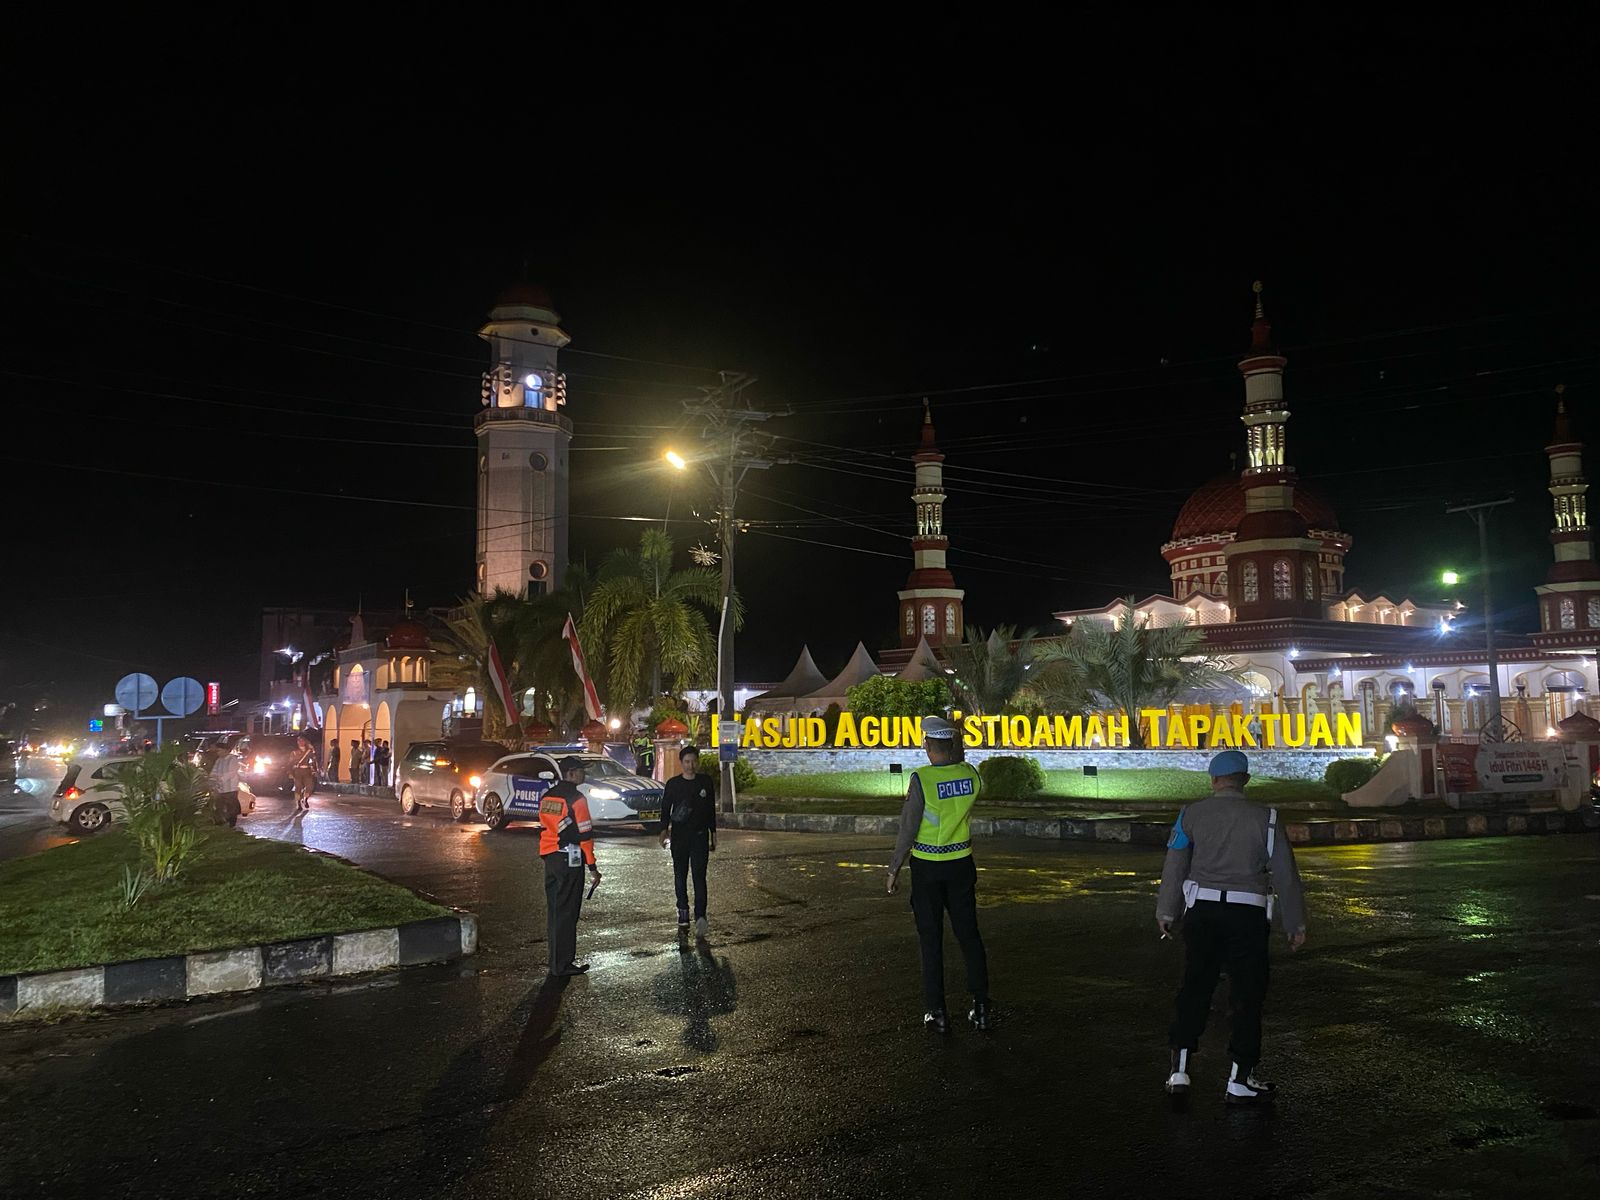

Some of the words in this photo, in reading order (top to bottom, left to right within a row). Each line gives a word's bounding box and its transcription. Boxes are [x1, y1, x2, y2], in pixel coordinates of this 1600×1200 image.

[834, 711, 927, 748] AGUN
[953, 709, 1131, 748] STIQAMAH
[1141, 709, 1362, 748] TAPAKTUAN
[515, 789, 539, 802] POLISI
[938, 780, 973, 798] POLISI
